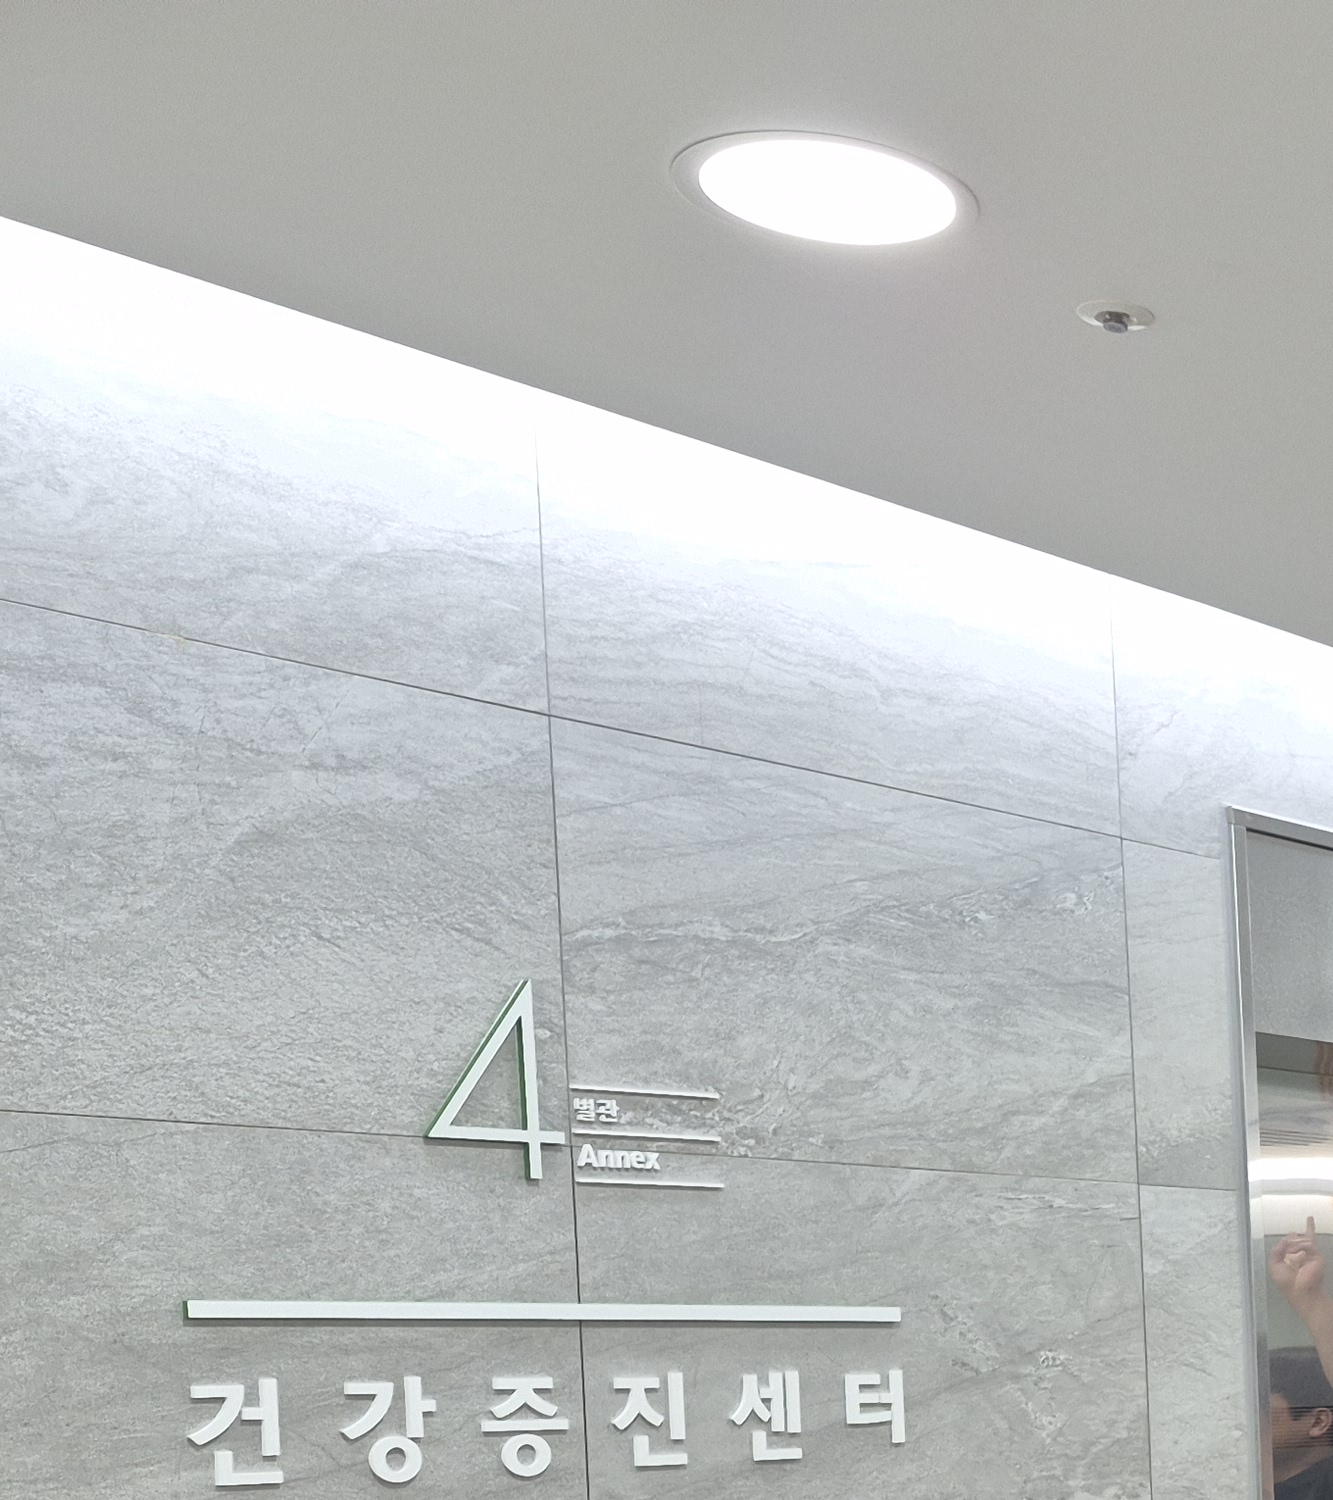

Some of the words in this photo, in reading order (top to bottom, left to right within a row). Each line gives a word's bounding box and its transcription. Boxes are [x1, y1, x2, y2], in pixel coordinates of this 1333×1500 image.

[424, 978, 566, 1181] 4
[573, 1097, 620, 1123] 별관
[577, 1143, 661, 1171] Annex
[186, 1369, 906, 1487] 건강증진센터
